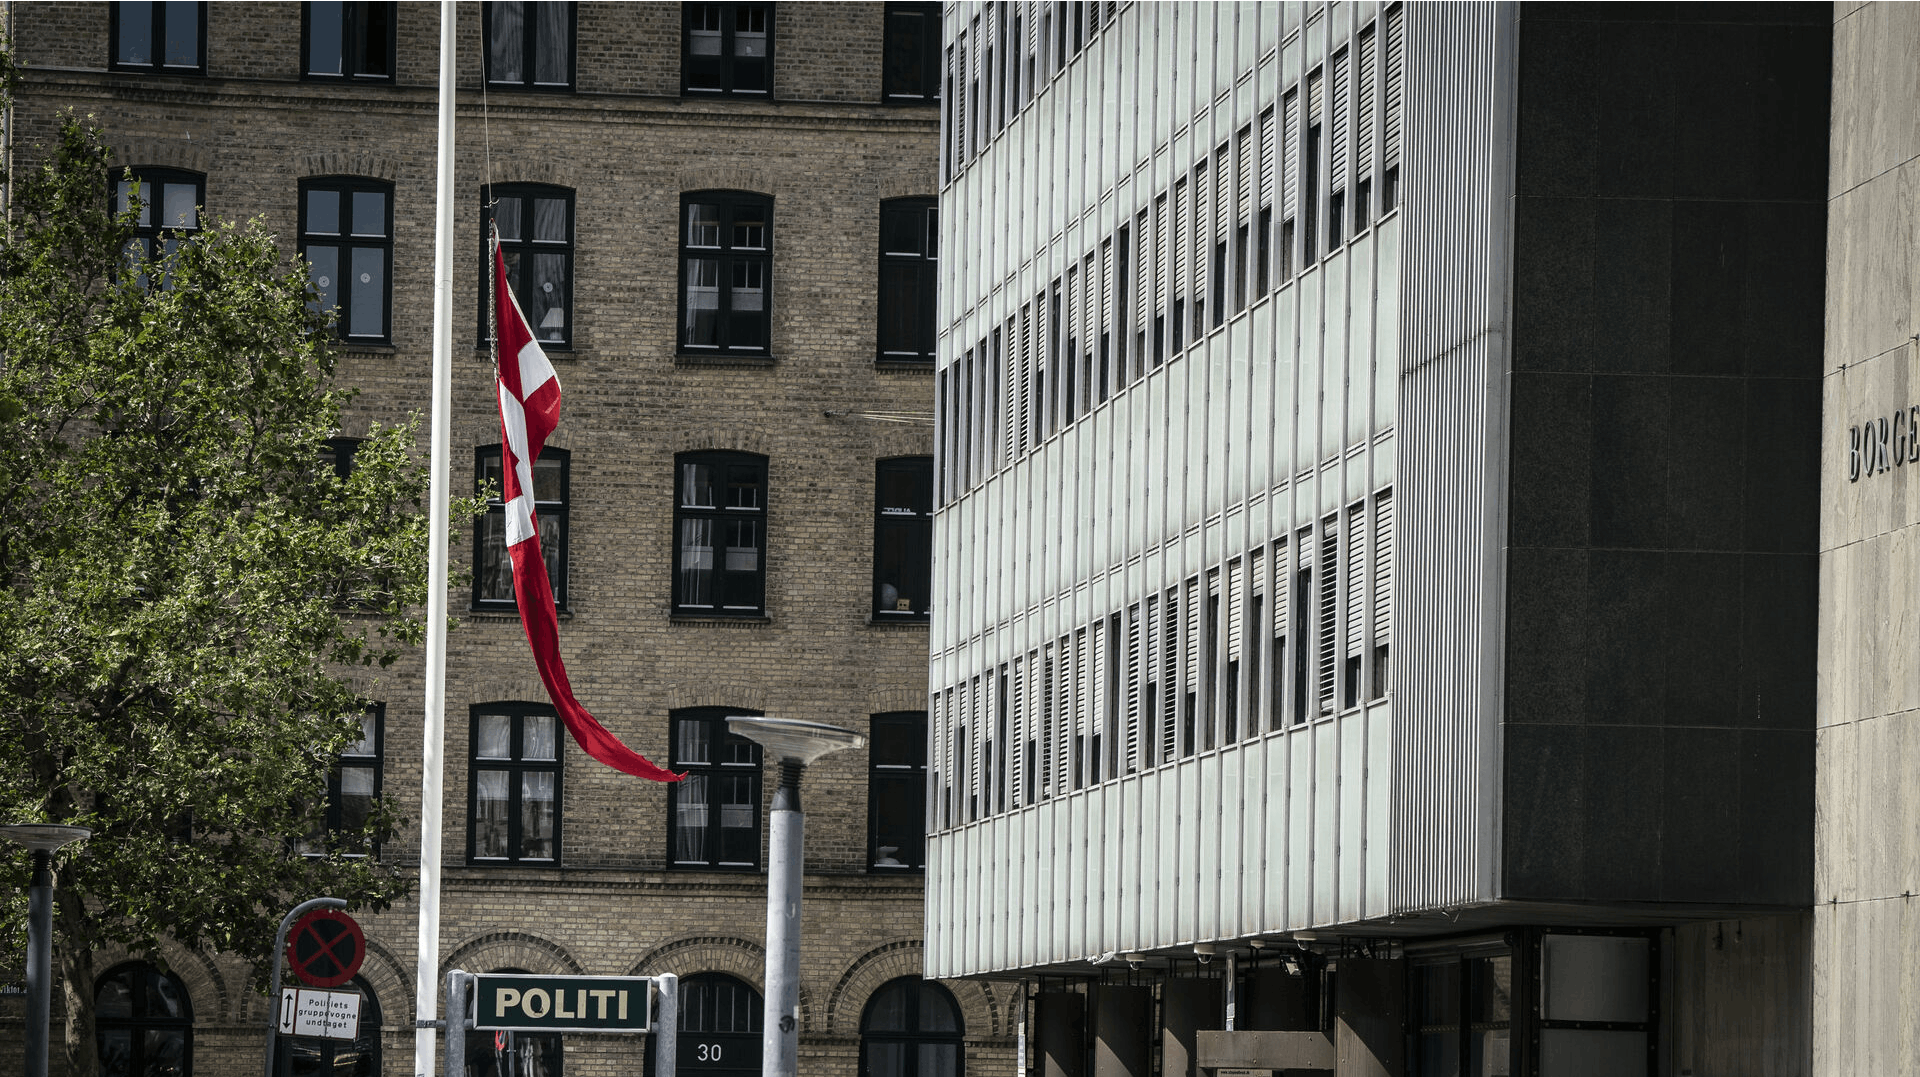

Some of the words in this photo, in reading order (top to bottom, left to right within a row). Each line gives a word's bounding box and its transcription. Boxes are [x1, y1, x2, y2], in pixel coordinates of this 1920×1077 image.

[1849, 405, 1920, 484] BORGE
[308, 999, 349, 1009] Politiets
[495, 987, 629, 1020] POLITI
[298, 1009, 357, 1020] gruppevogne
[306, 1019, 347, 1029] undtaget
[697, 1043, 722, 1061] 30
